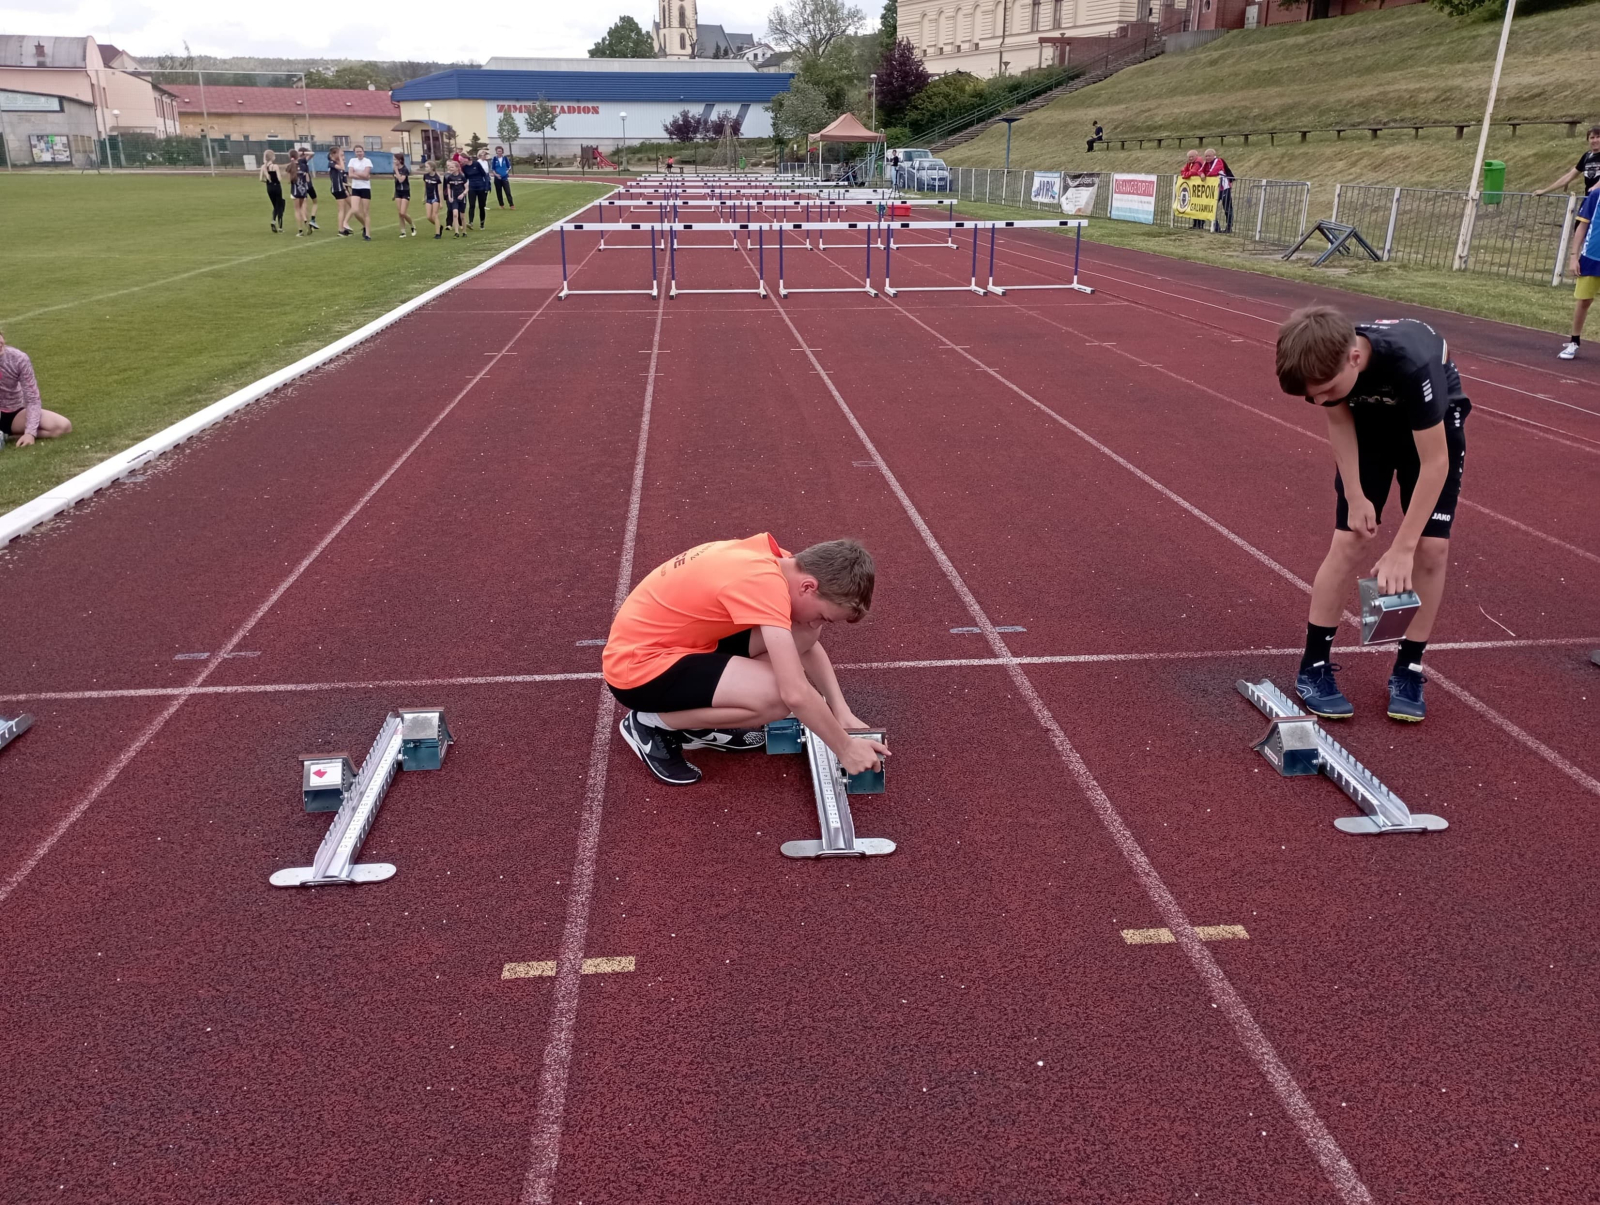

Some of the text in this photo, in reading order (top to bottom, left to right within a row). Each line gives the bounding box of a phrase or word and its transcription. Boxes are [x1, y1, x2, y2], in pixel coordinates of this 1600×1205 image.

[548, 105, 599, 115] TADION
[1115, 181, 1137, 193] ORANGE
[1191, 184, 1216, 199] REPON
[1432, 513, 1451, 521] JAKO
